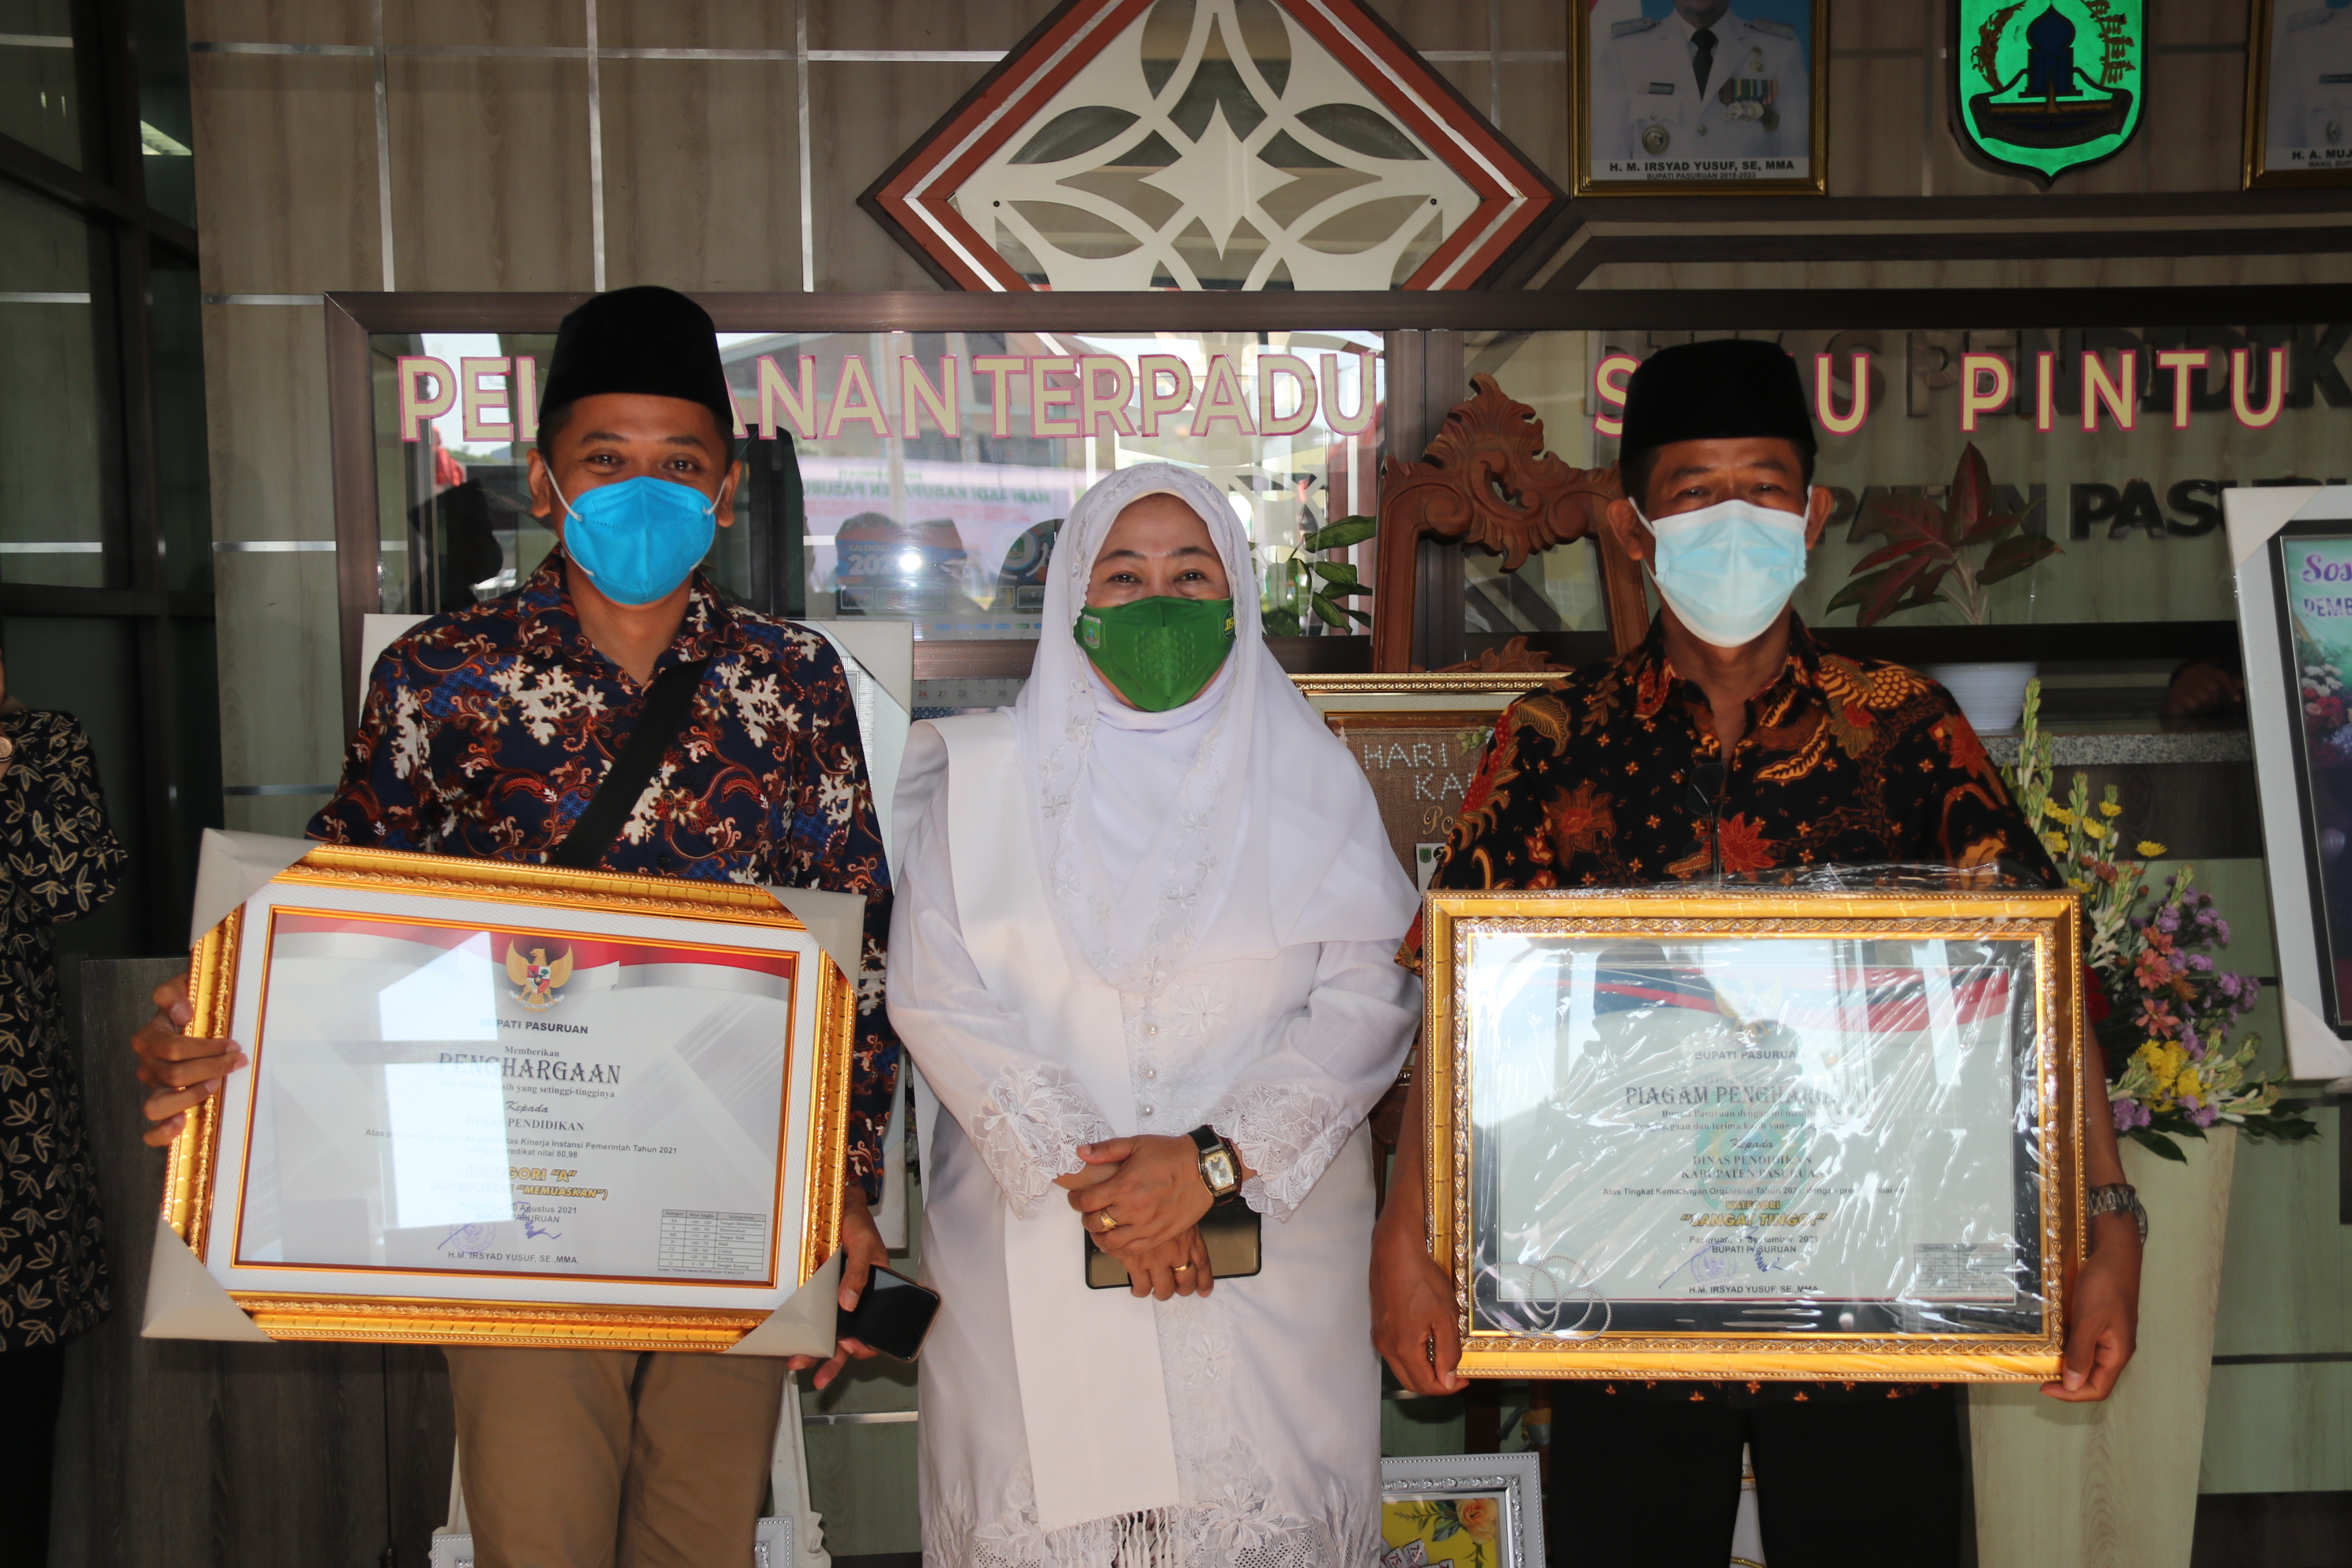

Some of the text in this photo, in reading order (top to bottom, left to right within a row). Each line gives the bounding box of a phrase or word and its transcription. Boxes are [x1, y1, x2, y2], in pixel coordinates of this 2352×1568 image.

[2309, 150, 2321, 160] A.
[1626, 163, 1640, 172] M.
[1645, 162, 1690, 172] IRSYAD
[1694, 161, 1738, 172] YUSUF,
[1742, 161, 1761, 172] SE,
[1765, 161, 1794, 170] MMA
[973, 352, 1378, 438] TERPADU
[1592, 352, 1871, 438] SU
[1960, 347, 2286, 433] PINTU
[1363, 742, 1448, 770] HARI
[525, 1021, 589, 1035] PASURUAN
[504, 1045, 560, 1058] Memberikan
[1694, 1050, 1805, 1060] BUPATI PASURUA
[438, 1052, 622, 1085] PENGHARGAAN
[516, 1085, 537, 1095] yang
[540, 1086, 616, 1099] setinggi-tingginya
[1624, 1085, 1709, 1106] PIAGAM
[505, 1100, 550, 1114] Kepada
[1694, 1109, 1736, 1118] Pasuruan
[507, 1118, 585, 1132] PENDIDIKAN
[1693, 1121, 1709, 1130] dan
[1712, 1121, 1740, 1130] terima
[365, 1129, 384, 1137] Atas
[521, 1137, 550, 1149] Kinerja
[552, 1139, 584, 1149] Instansi
[586, 1142, 631, 1152] Pemerintah
[633, 1144, 658, 1153] Tahun
[537, 1149, 555, 1158] nilai
[556, 1150, 579, 1159] 80,98
[1693, 1155, 1731, 1165] DINAS
[1602, 1187, 1622, 1196] Atas
[1623, 1187, 1654, 1197] Tingkat
[1709, 1187, 1755, 1197] Organisasi
[519, 1204, 556, 1214] Agustus
[558, 1205, 578, 1214] 2021
[1725, 1200, 1781, 1211] KATEGORI
[1712, 1245, 1744, 1253] BUPATI
[469, 1251, 503, 1261] IRSYAD
[505, 1253, 537, 1263] YUSUF,
[1709, 1285, 1743, 1294] IRSYAD
[1746, 1286, 1778, 1295] YUSUF,
